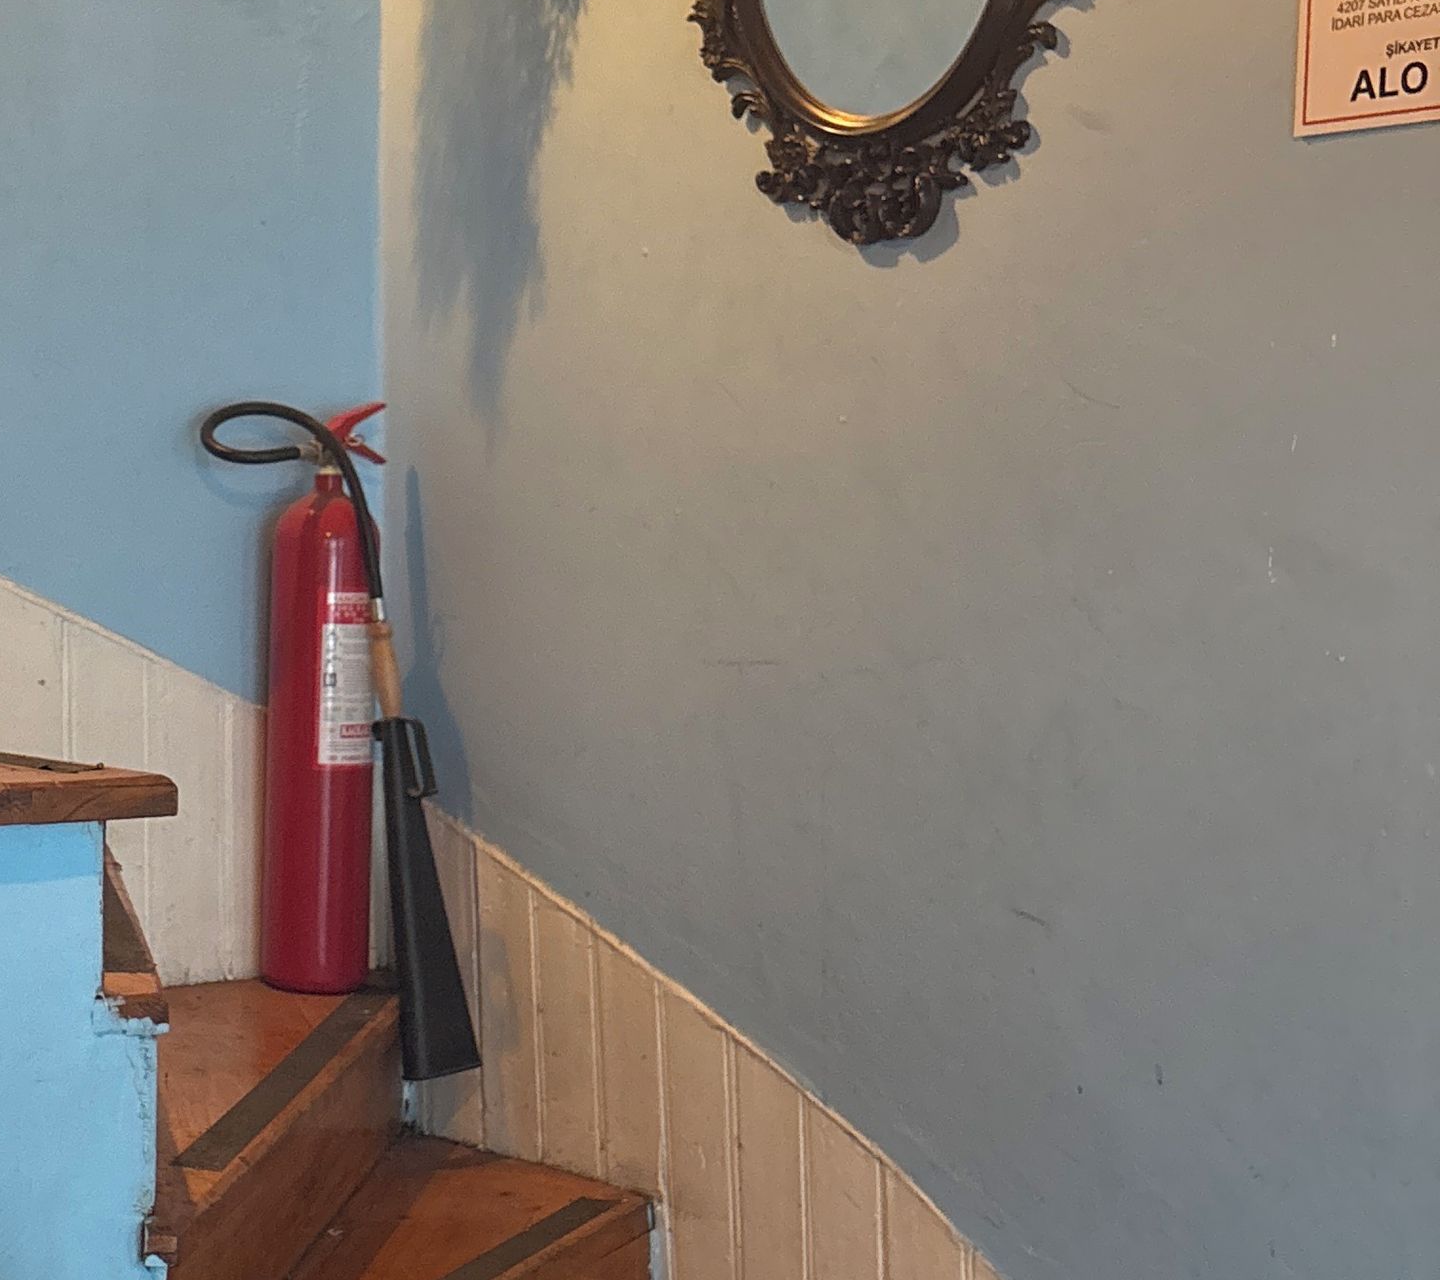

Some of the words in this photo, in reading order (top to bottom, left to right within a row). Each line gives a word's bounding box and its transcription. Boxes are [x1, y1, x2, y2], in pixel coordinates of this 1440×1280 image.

[1331, 12, 1365, 32] İDARİ
[1368, 9, 1401, 25] PARA
[1404, 2, 1440, 20] CEZA
[1337, 0, 1366, 14] 4207
[1350, 61, 1428, 102] ALO
